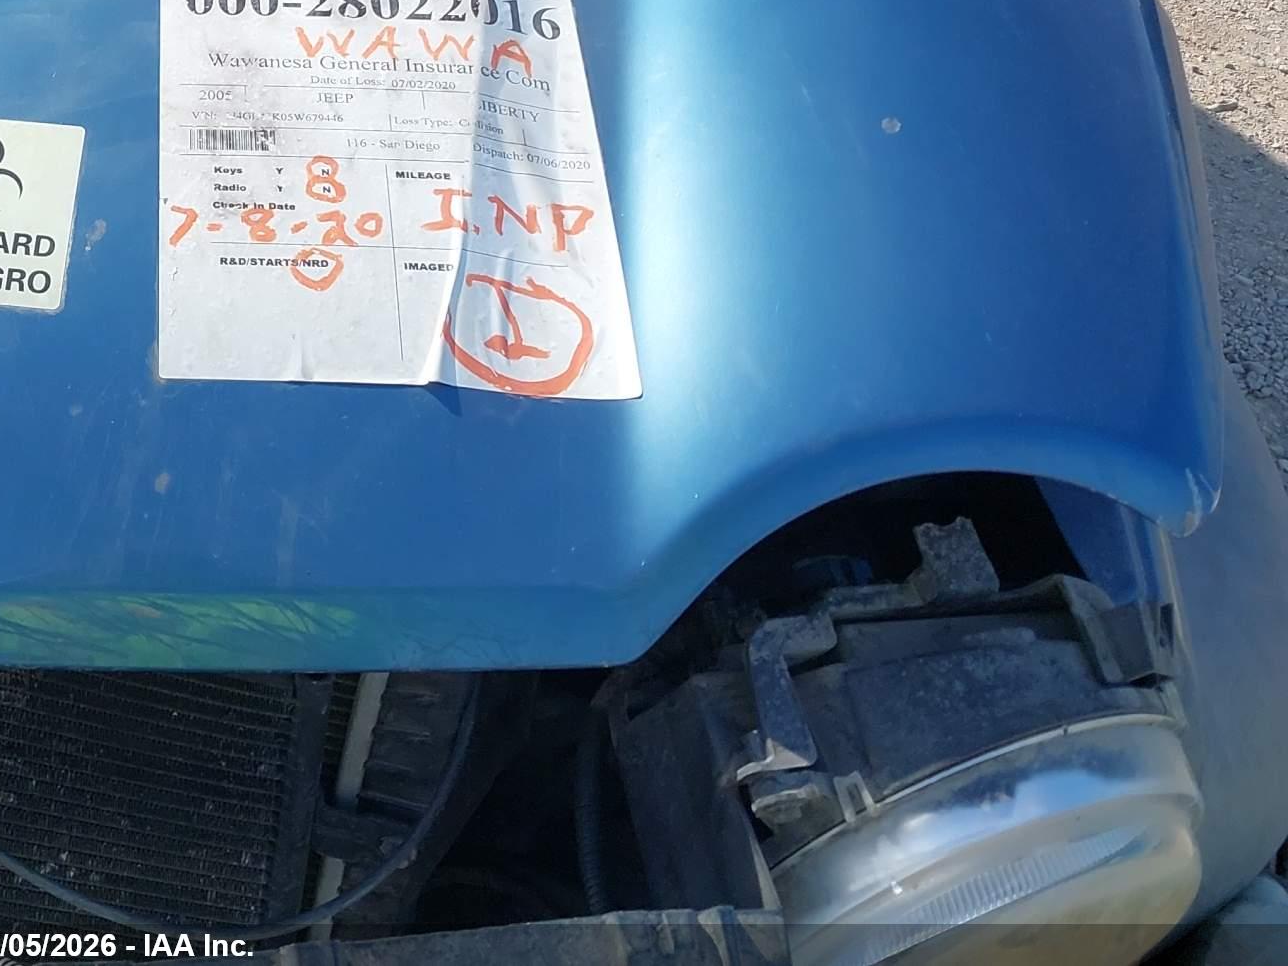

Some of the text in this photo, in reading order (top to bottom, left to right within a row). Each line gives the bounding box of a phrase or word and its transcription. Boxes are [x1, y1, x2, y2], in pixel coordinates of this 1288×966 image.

[208, 53, 313, 69] Wawanesa
[320, 55, 397, 71] General
[311, 75, 457, 91] Date of Loss: 07/02/2020
[199, 89, 233, 101] 2005
[316, 92, 354, 104] JEEP
[192, 111, 217, 121] VN:
[478, 99, 540, 123] IBERTY
[394, 116, 419, 125] Loss
[421, 117, 452, 128] Type:
[347, 138, 367, 148] 116
[379, 139, 401, 149] San
[405, 139, 441, 152] Diego
[473, 142, 591, 170] Dispatch: 07/06/2020
[214, 166, 330, 176] Keys Y N
[395, 171, 451, 180] MILEAGE
[214, 184, 331, 194] Radio Y N
[212, 201, 297, 211] Check In Date
[219, 256, 330, 268] R&D/STARTS/NRD
[404, 262, 454, 272] IMAGED
